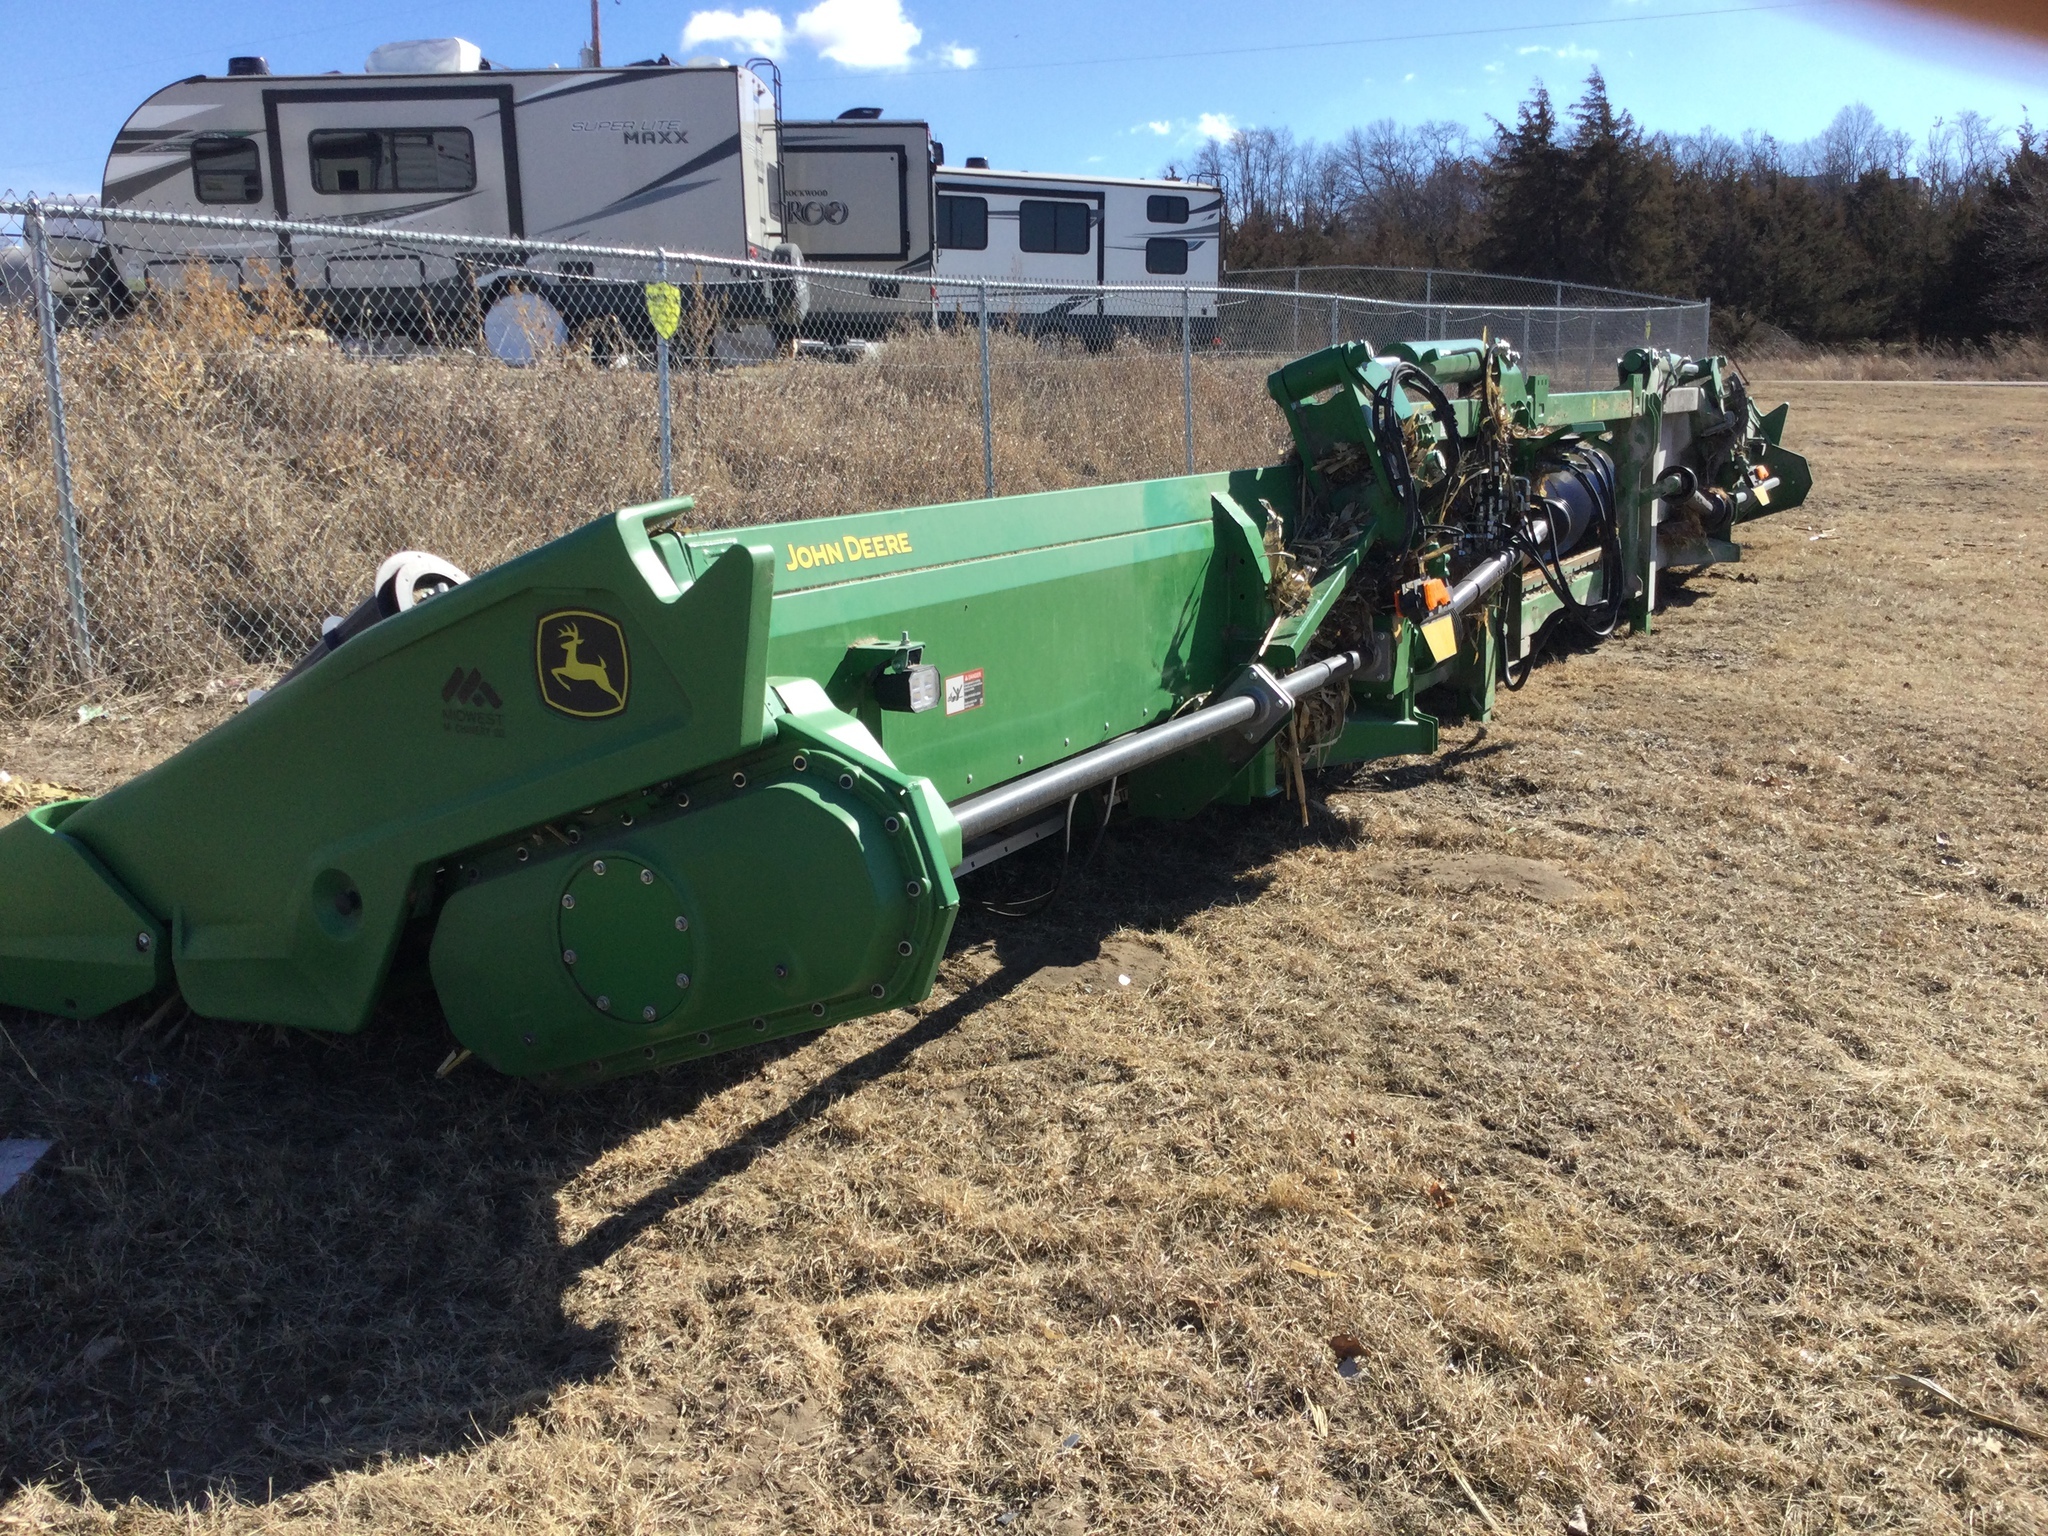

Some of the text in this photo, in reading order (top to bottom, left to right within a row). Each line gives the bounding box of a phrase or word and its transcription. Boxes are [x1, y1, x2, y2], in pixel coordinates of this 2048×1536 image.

[571, 120, 681, 132] SUPER LITE
[623, 131, 689, 144] MAXX
[786, 532, 913, 571] JOHN DEERE
